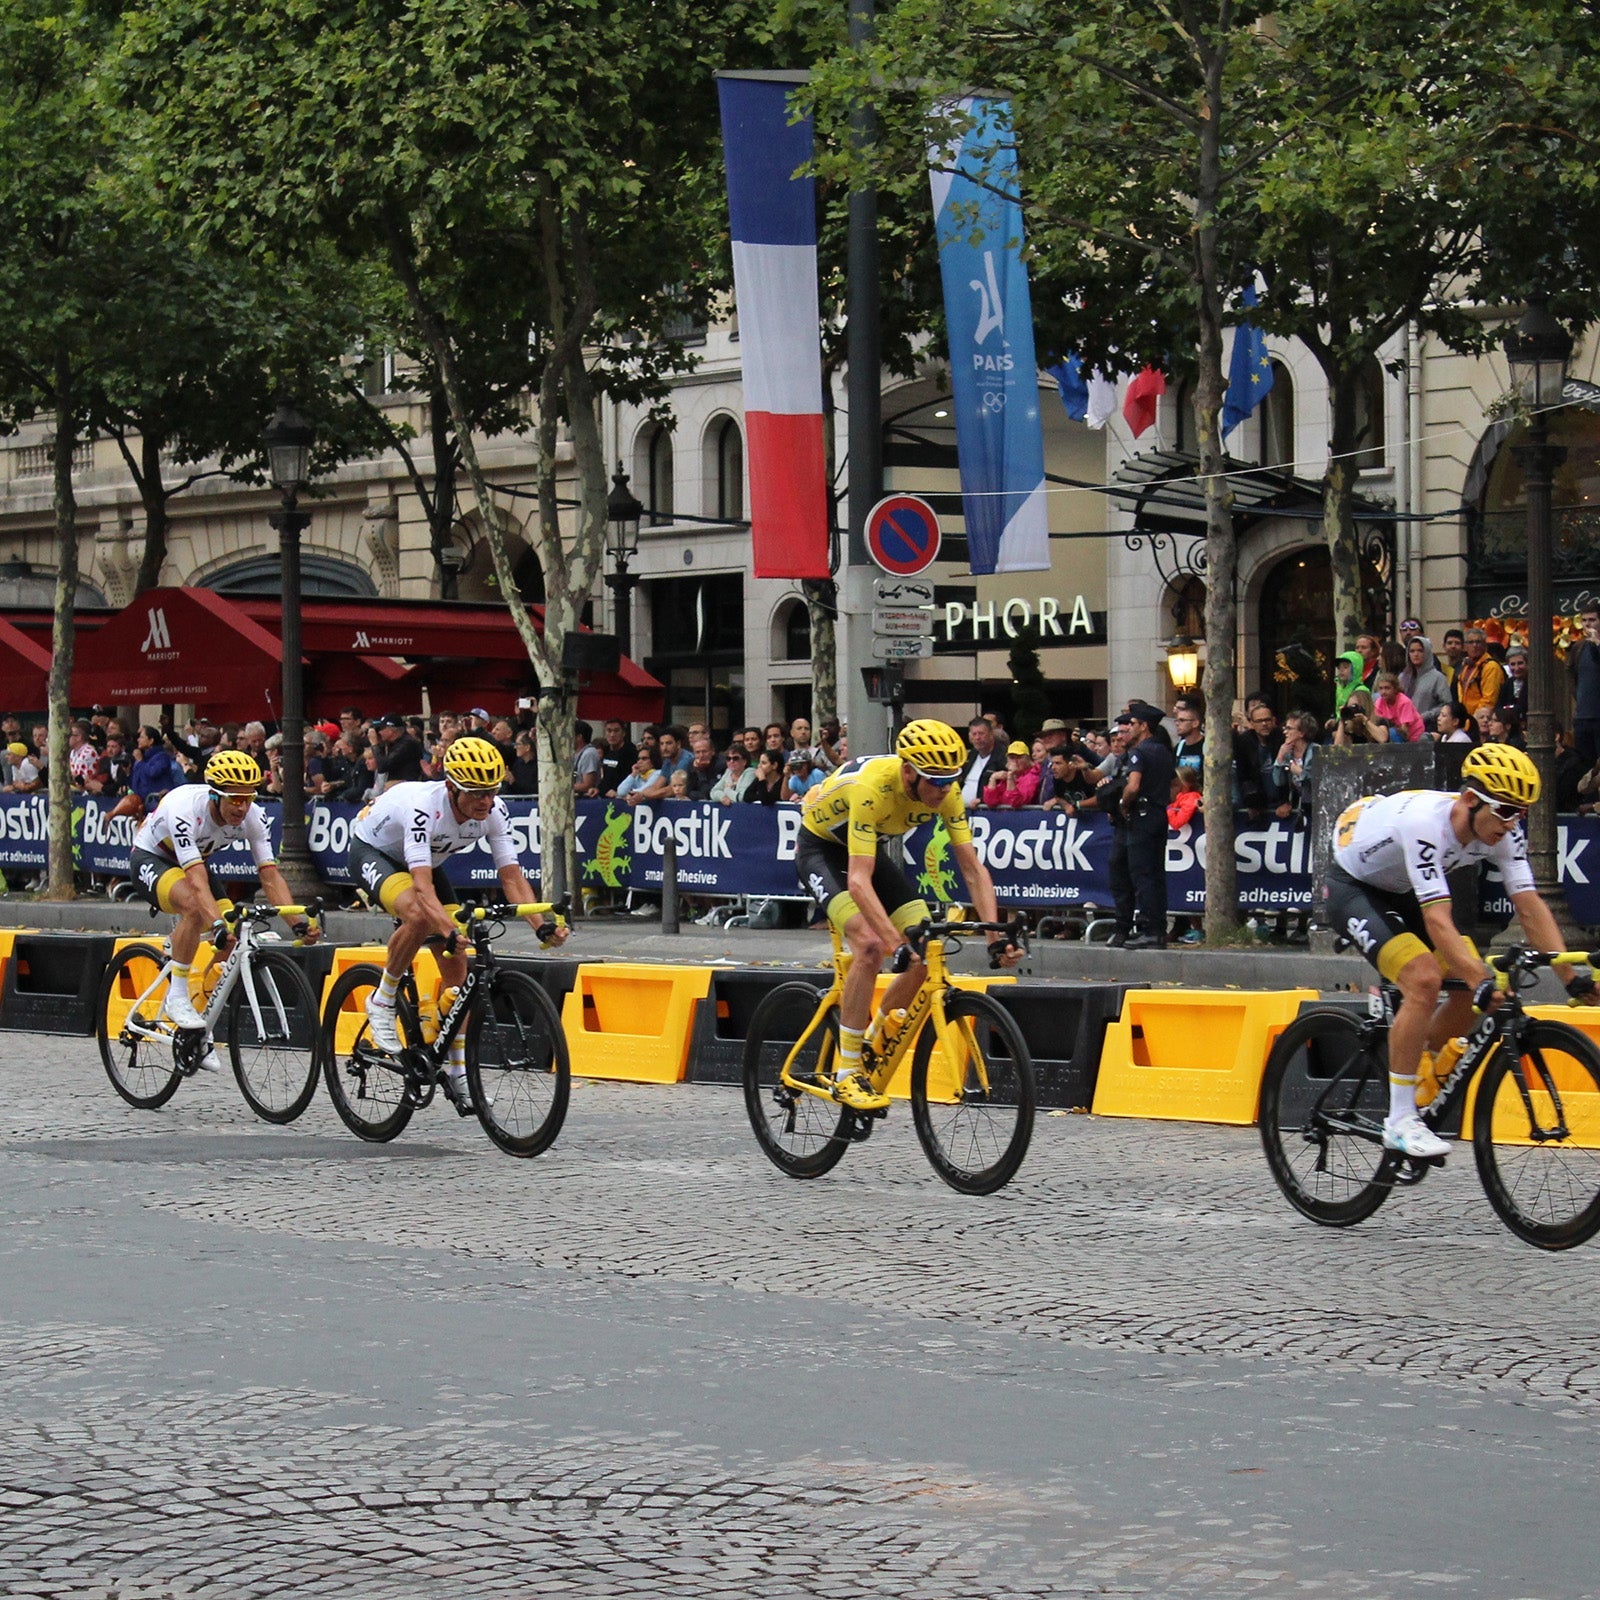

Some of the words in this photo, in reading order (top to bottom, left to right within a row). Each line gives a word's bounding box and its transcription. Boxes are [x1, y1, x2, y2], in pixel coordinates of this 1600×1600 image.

[973, 353, 1014, 371] PARS
[945, 595, 1094, 641] PHORA
[371, 637, 414, 645] MARRIOTT
[147, 651, 181, 660] MARRIOTT
[111, 688, 129, 696] PARIS
[130, 687, 158, 695] MARRIOTT
[0, 796, 50, 840] stik
[633, 804, 732, 858] Bostik
[968, 813, 1094, 871] Bostik
[1164, 815, 1313, 874] Bsti
[10, 851, 45, 863] adhesives
[219, 862, 258, 875] adhesive
[327, 867, 350, 877] smart
[470, 869, 498, 879] smar
[645, 870, 664, 881] smar
[677, 869, 718, 885] dhesives
[993, 884, 1020, 897] mart
[1022, 884, 1080, 898] adhesives
[1238, 888, 1314, 903] adhesive
[432, 972, 475, 1053] PINARELLO
[876, 989, 928, 1078] PINARELLO
[1430, 1016, 1496, 1117] PINARELLO
